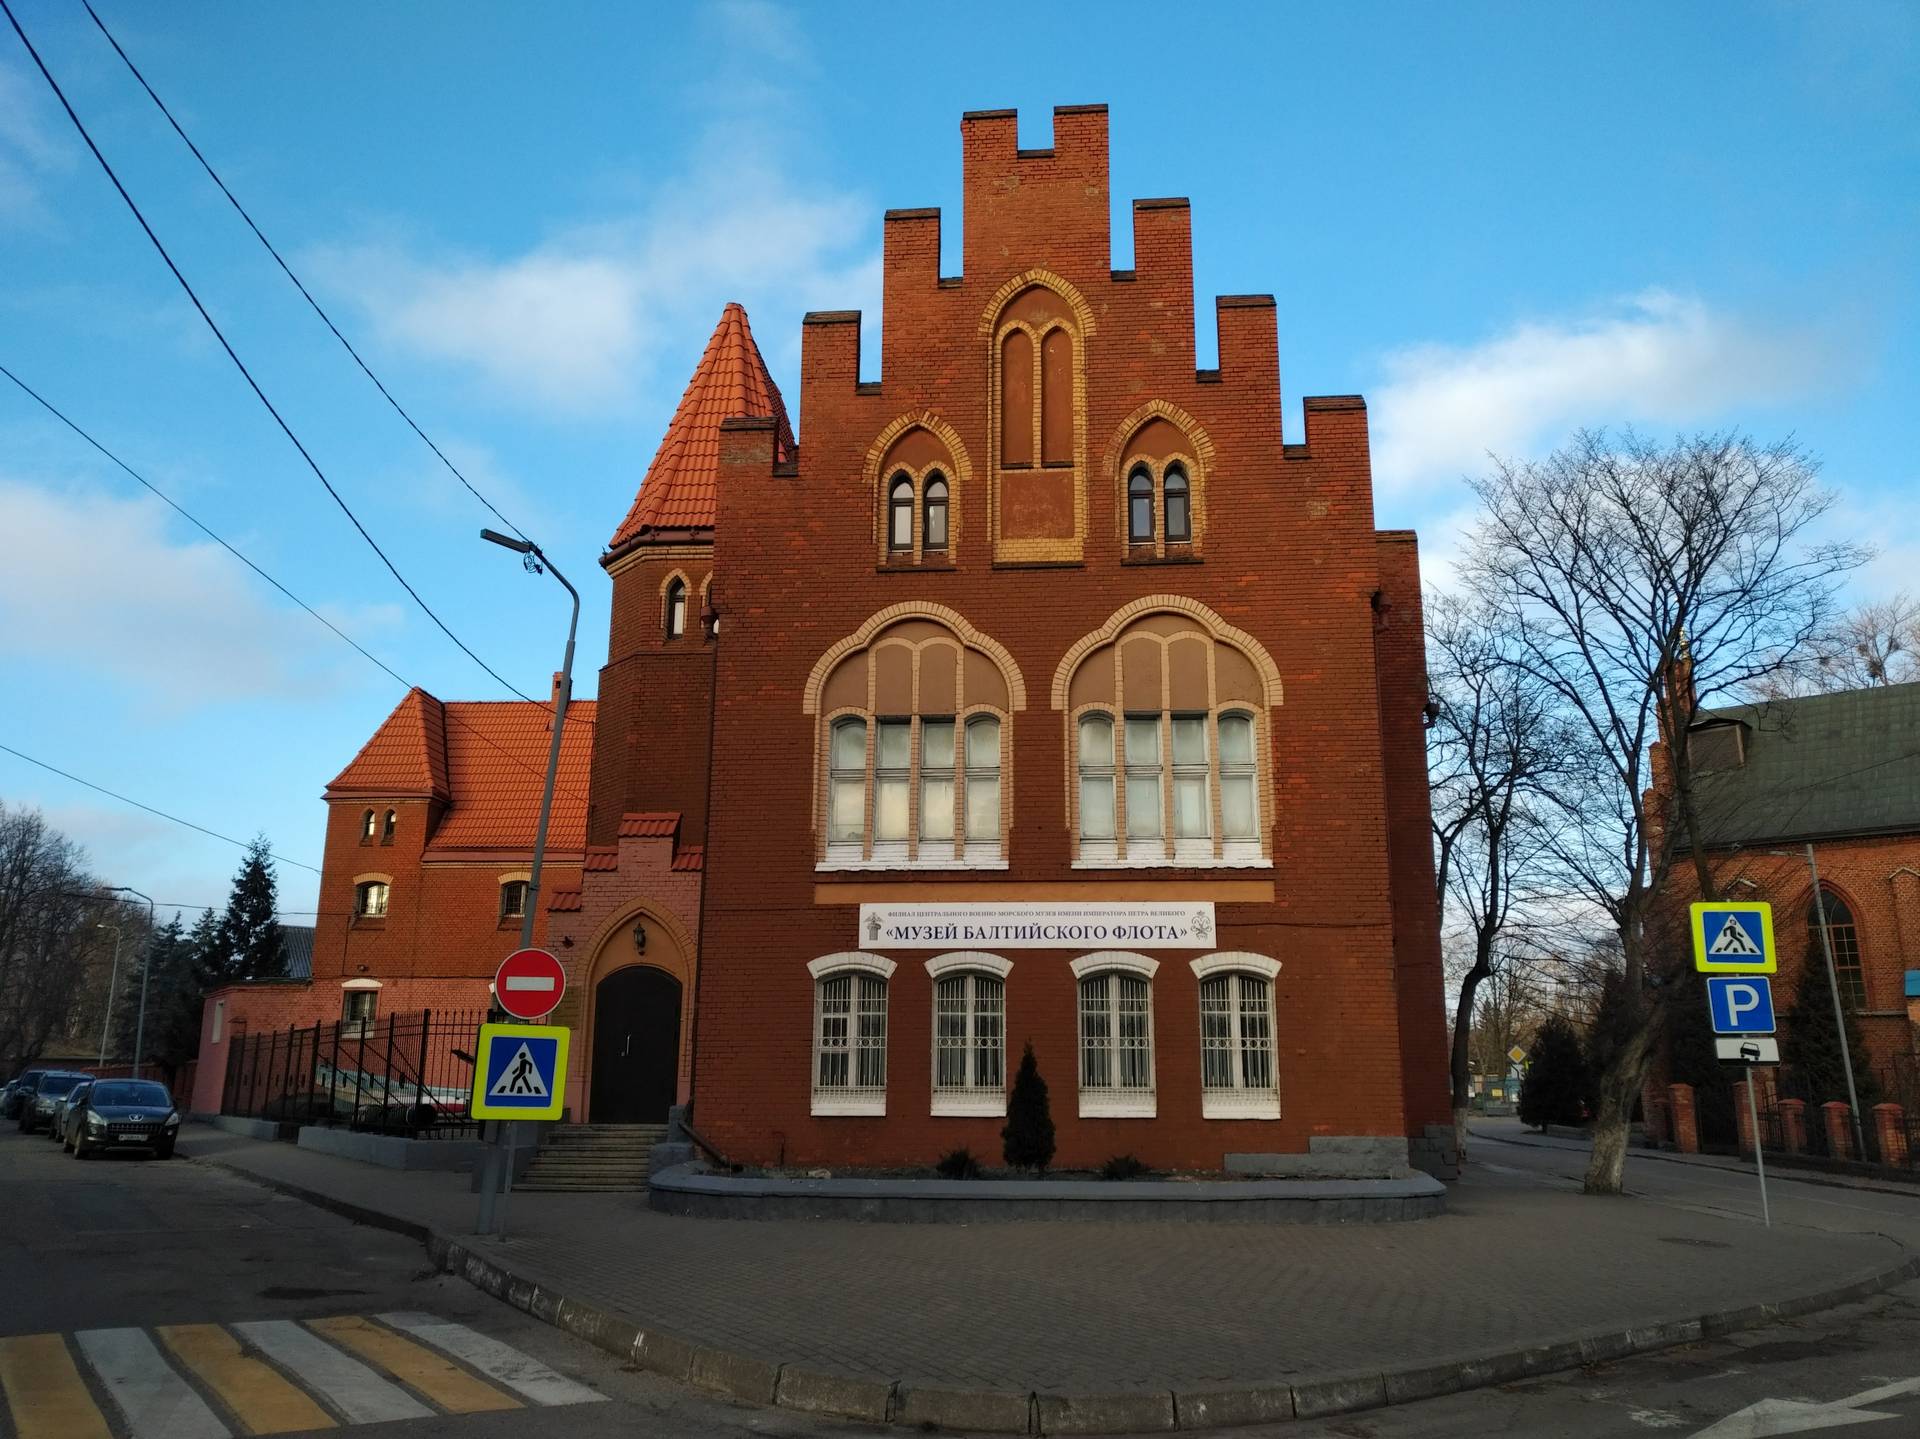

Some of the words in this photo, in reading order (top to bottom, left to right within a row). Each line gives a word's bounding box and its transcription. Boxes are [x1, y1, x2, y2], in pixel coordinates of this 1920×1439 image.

[886, 923, 958, 940] «МУЗЕЙ
[964, 922, 1107, 940] БАЛТИЙСКОГО
[1112, 925, 1187, 940] ФЛОТА»
[1725, 984, 1760, 1027] P
